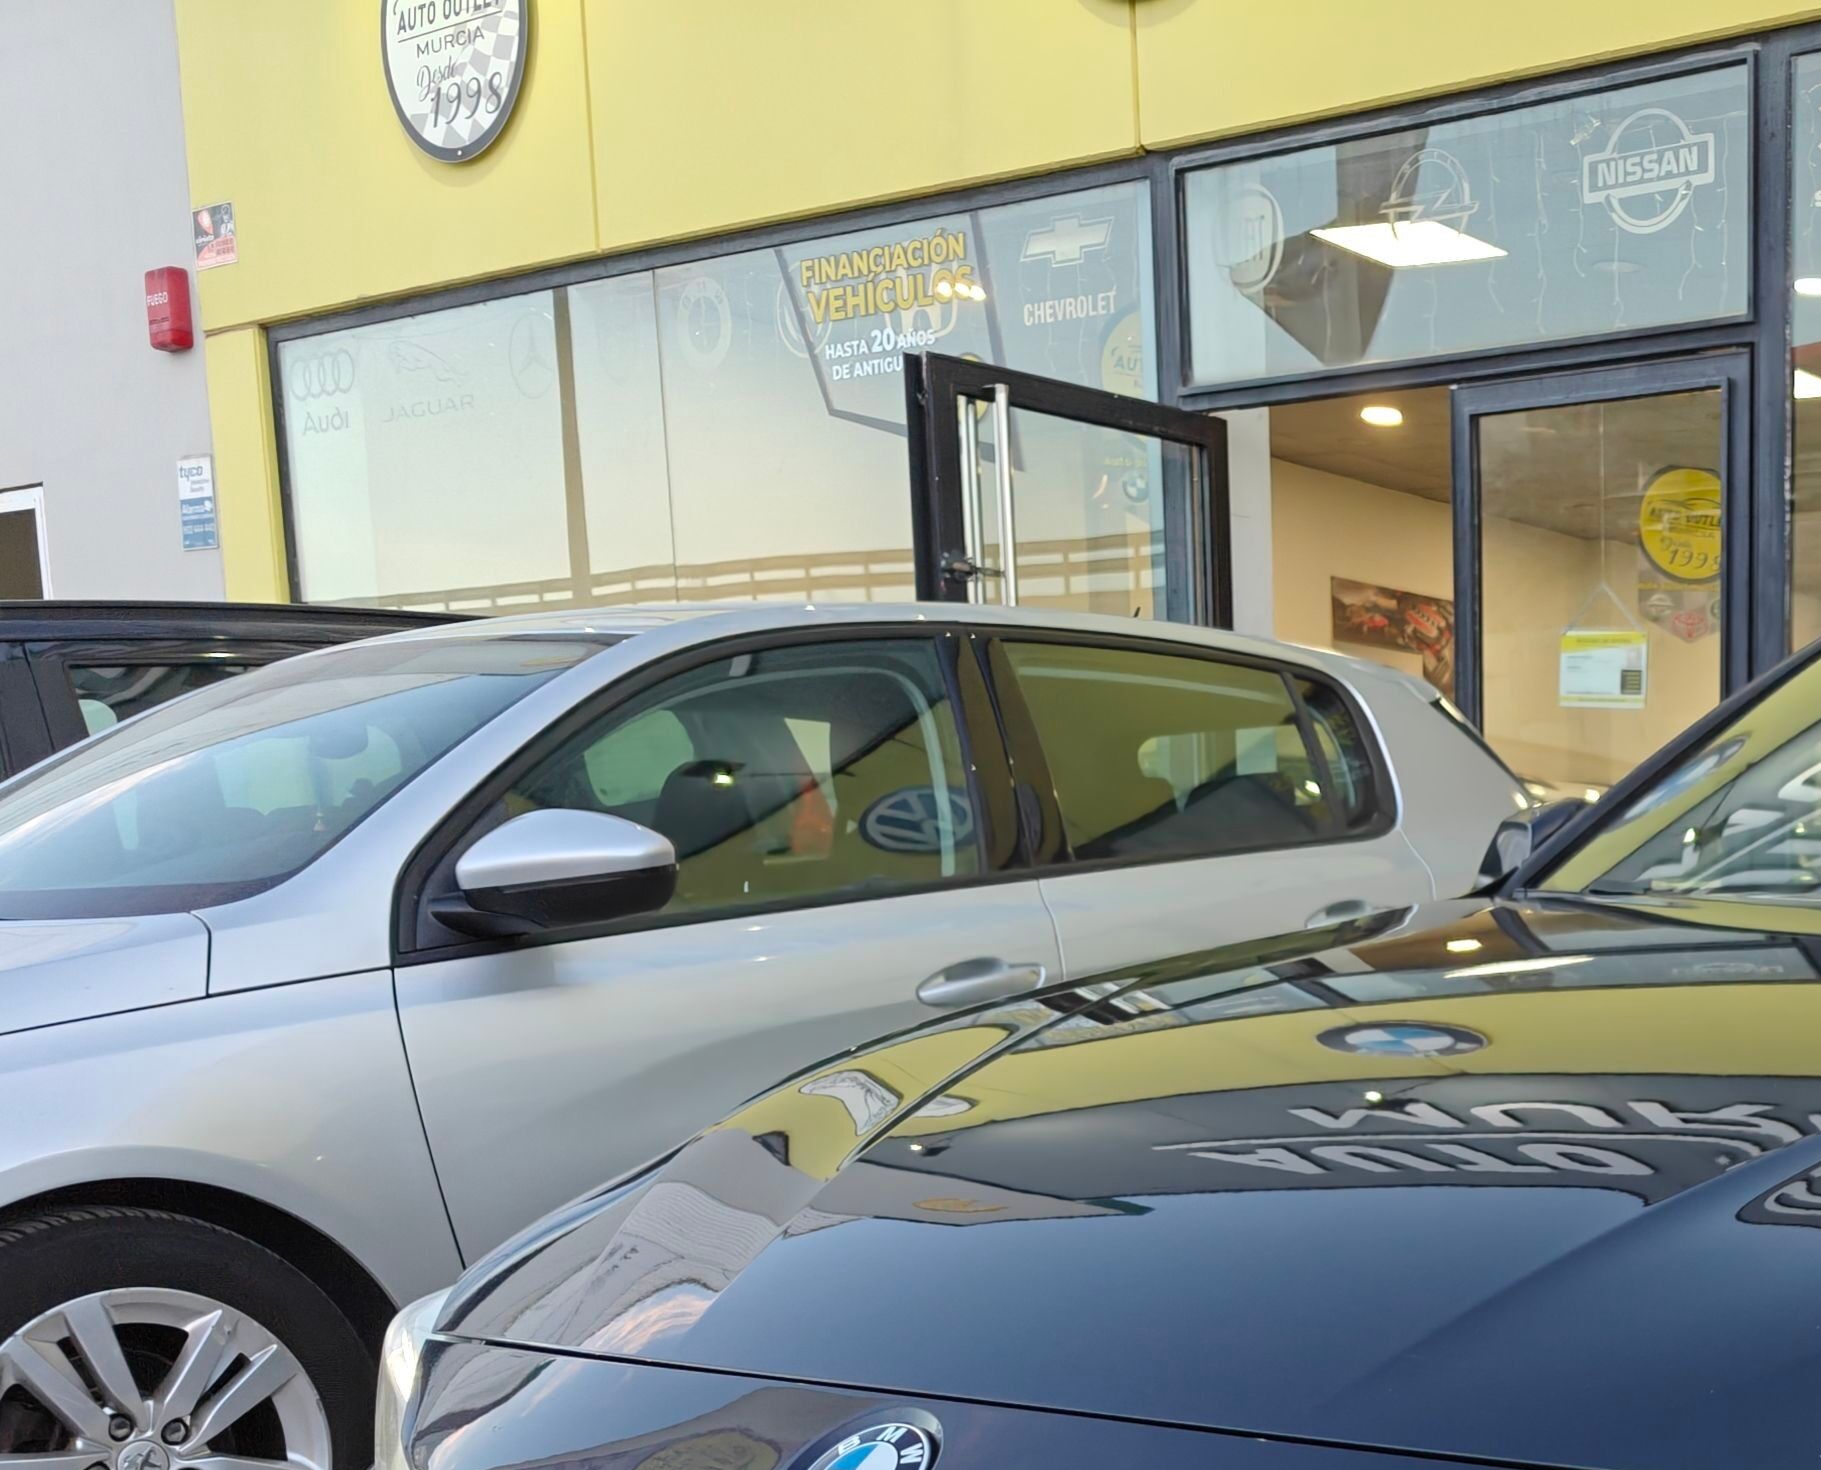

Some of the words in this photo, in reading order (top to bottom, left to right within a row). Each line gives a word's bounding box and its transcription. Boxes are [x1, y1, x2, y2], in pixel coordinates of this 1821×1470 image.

[397, 1, 436, 35] AUTO
[416, 25, 486, 59] MURCIA
[430, 71, 503, 128] 1998
[1597, 145, 1699, 188] NISSAN
[800, 228, 967, 287] FINANCIACIÓN
[806, 265, 977, 325] VEHÍCULOS
[1023, 291, 1117, 327] CHEVROLET
[825, 339, 869, 360] HASTA
[870, 328, 896, 353] 20
[896, 328, 936, 349] AÑOS
[832, 363, 851, 381] DE
[853, 356, 904, 378] ANTIGU
[303, 406, 349, 436] Audi
[383, 394, 475, 423] JAGUAR
[178, 465, 204, 480] tyco
[837, 1426, 925, 1464] BMW
